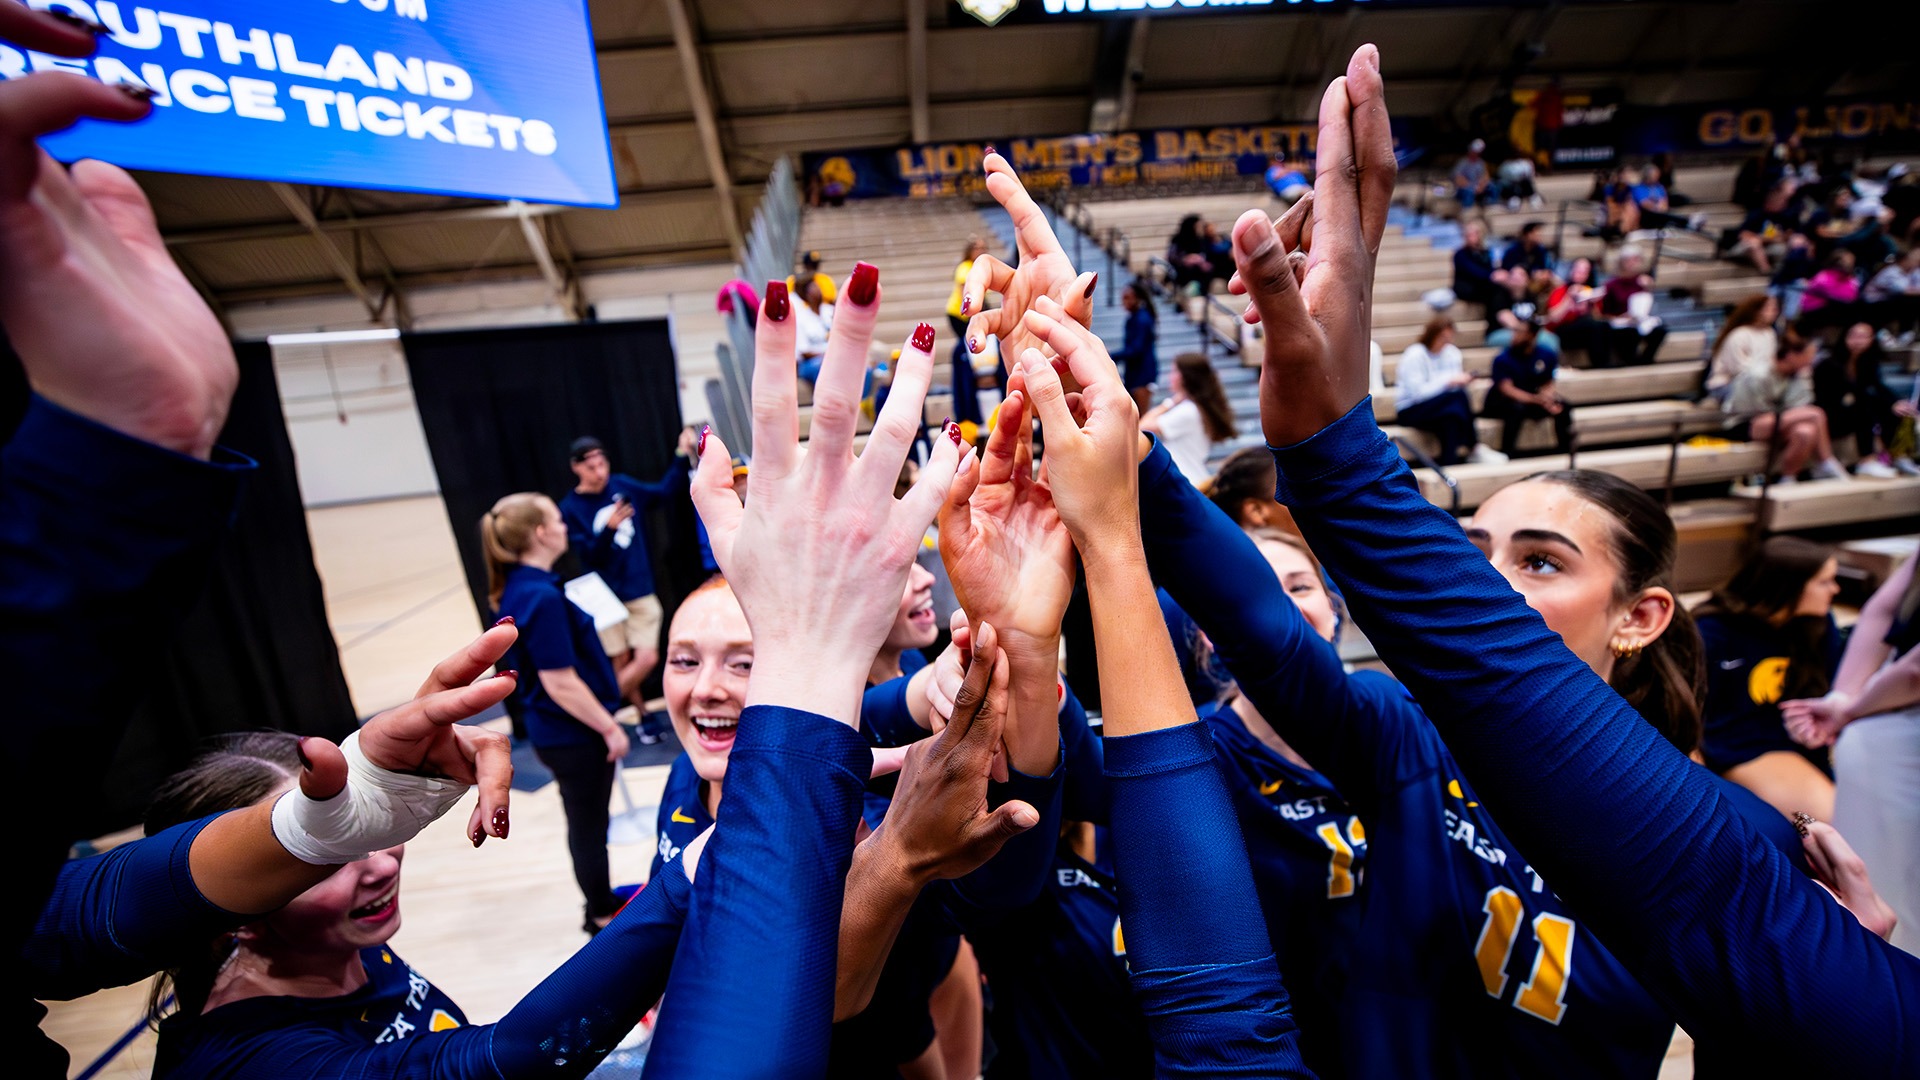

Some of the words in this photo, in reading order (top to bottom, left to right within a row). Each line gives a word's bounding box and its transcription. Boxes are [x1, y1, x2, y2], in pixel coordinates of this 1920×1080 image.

[289, 85, 558, 156] TICKETS
[1697, 108, 1774, 145] GO
[1793, 102, 1920, 139] LION
[1473, 885, 1576, 1027] 11
